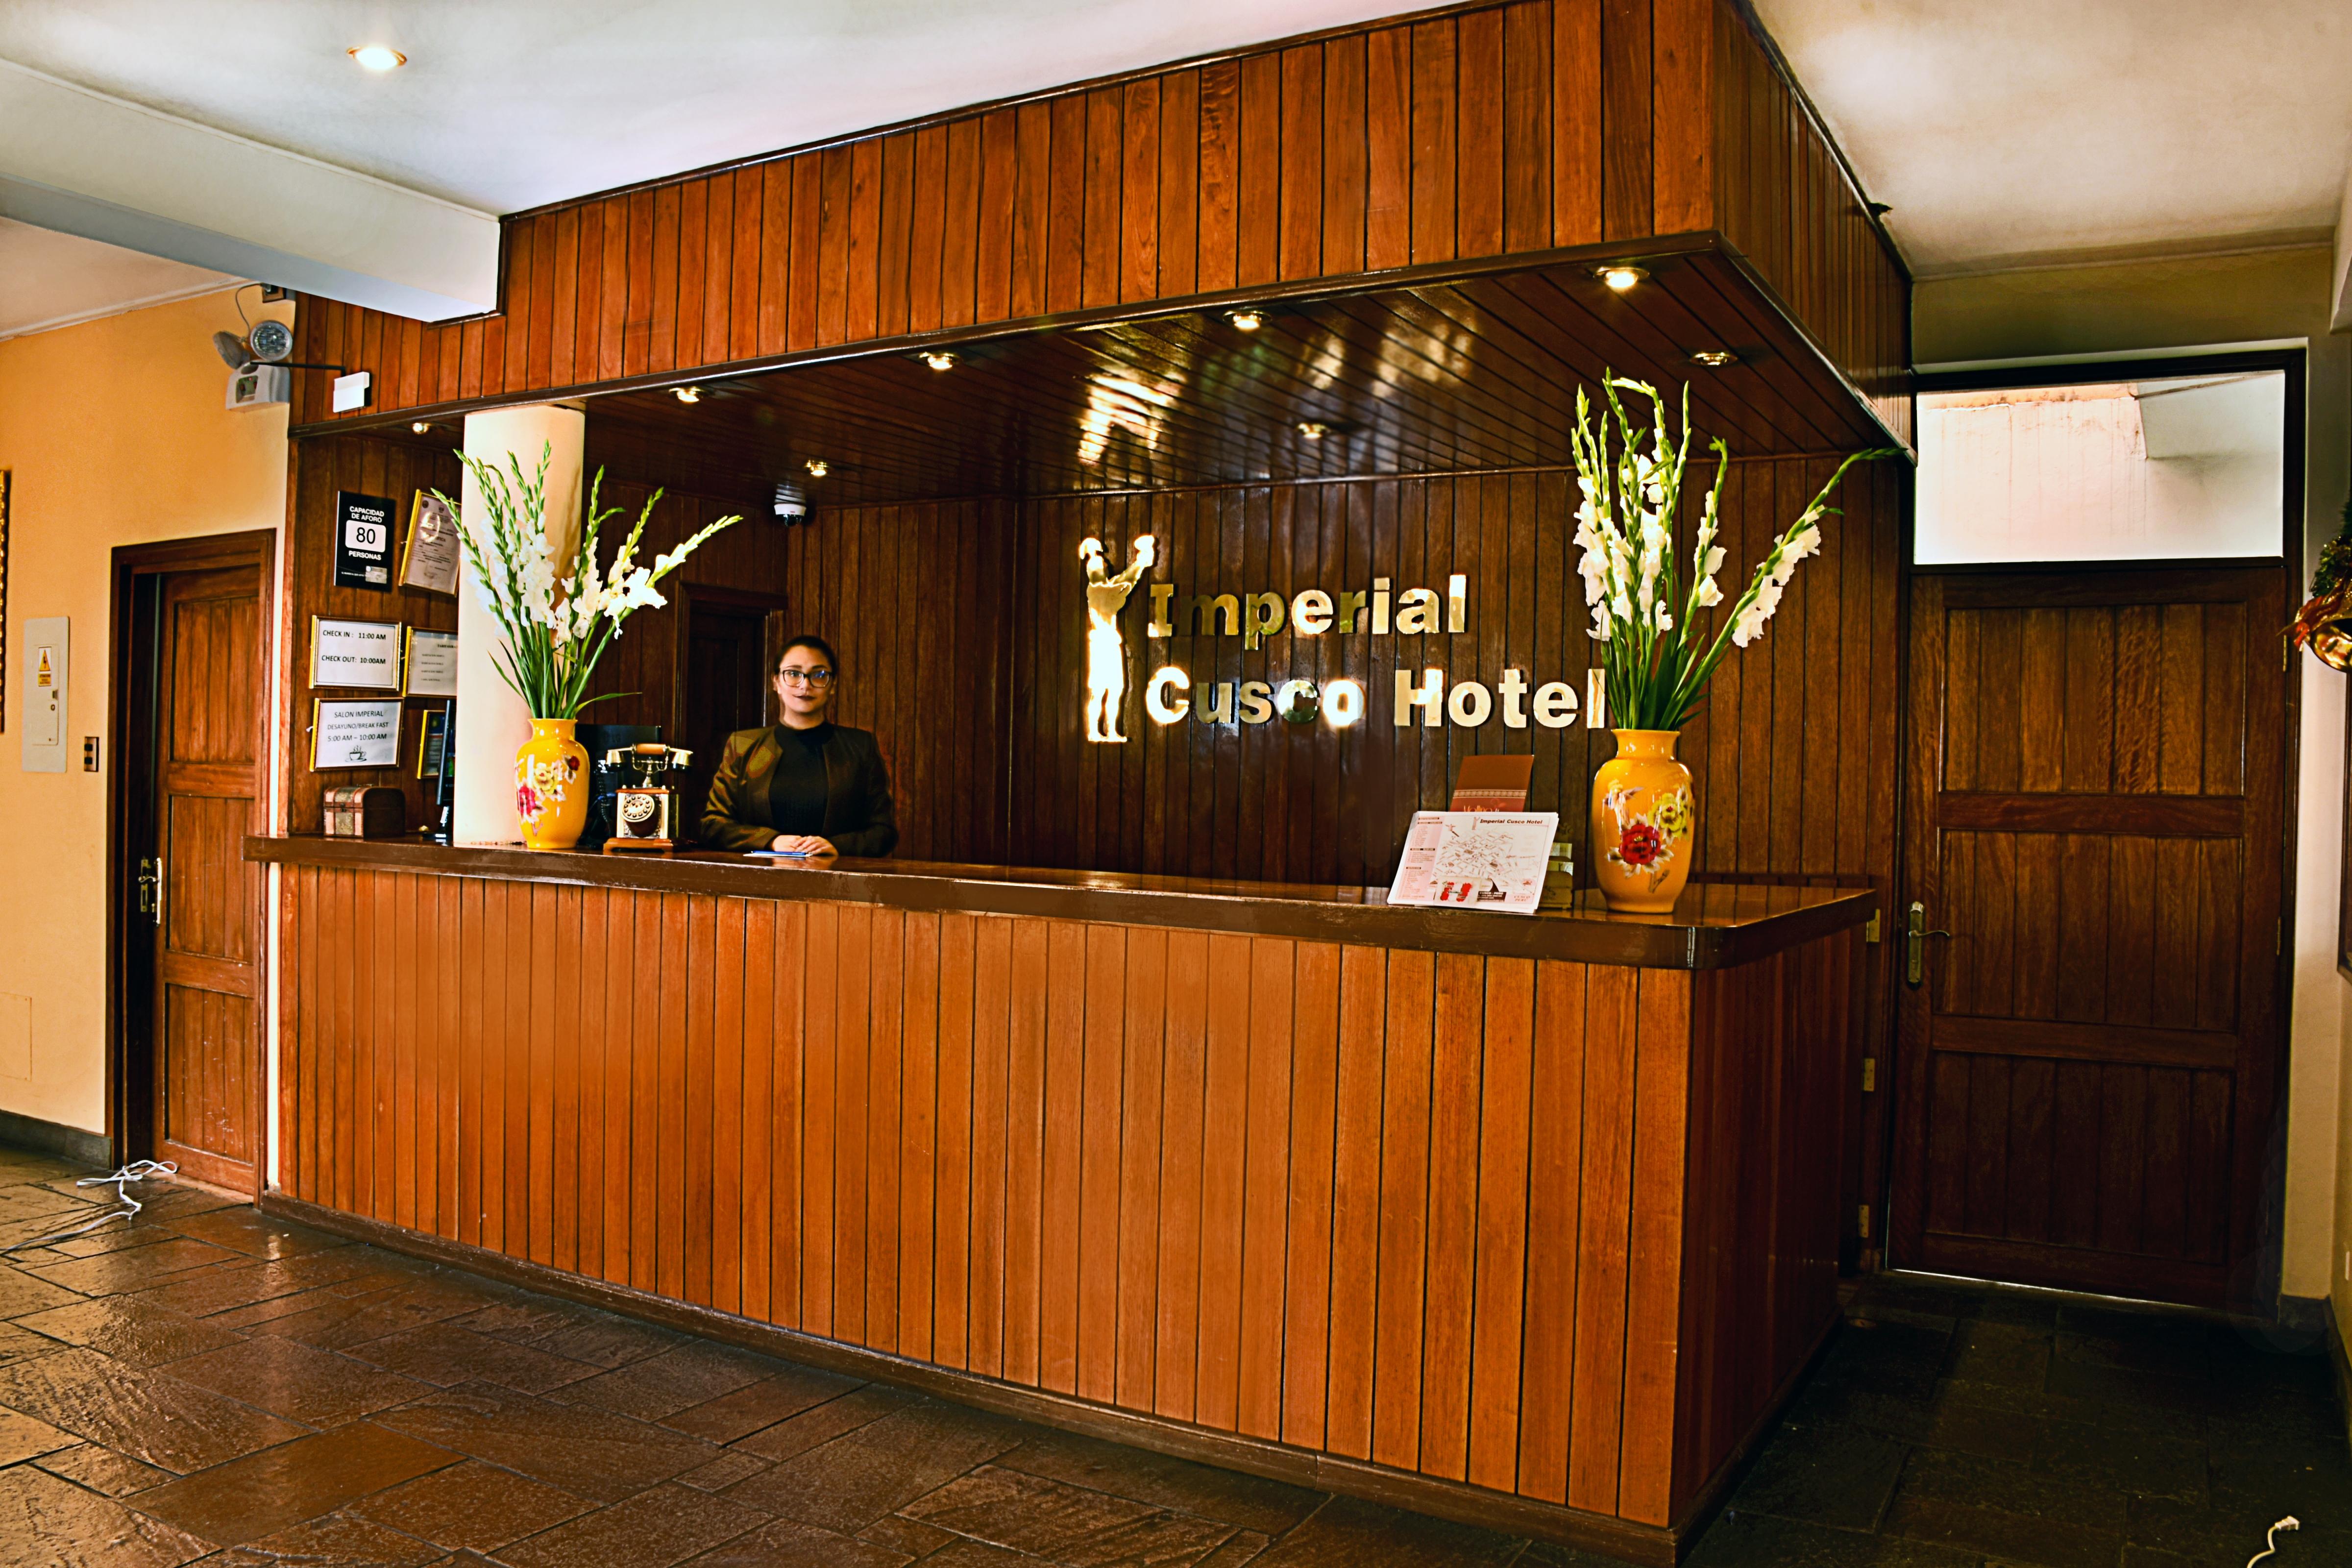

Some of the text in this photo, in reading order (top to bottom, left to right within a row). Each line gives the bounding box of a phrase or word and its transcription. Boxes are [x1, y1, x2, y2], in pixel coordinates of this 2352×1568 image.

[349, 506, 385, 517] CAPACIDAD
[361, 514, 382, 523] AFORO
[356, 527, 376, 544] 80
[348, 550, 382, 561] PERSONAS
[1147, 574, 1467, 650] Imperial
[1146, 665, 1605, 729] Cusco Hotel
